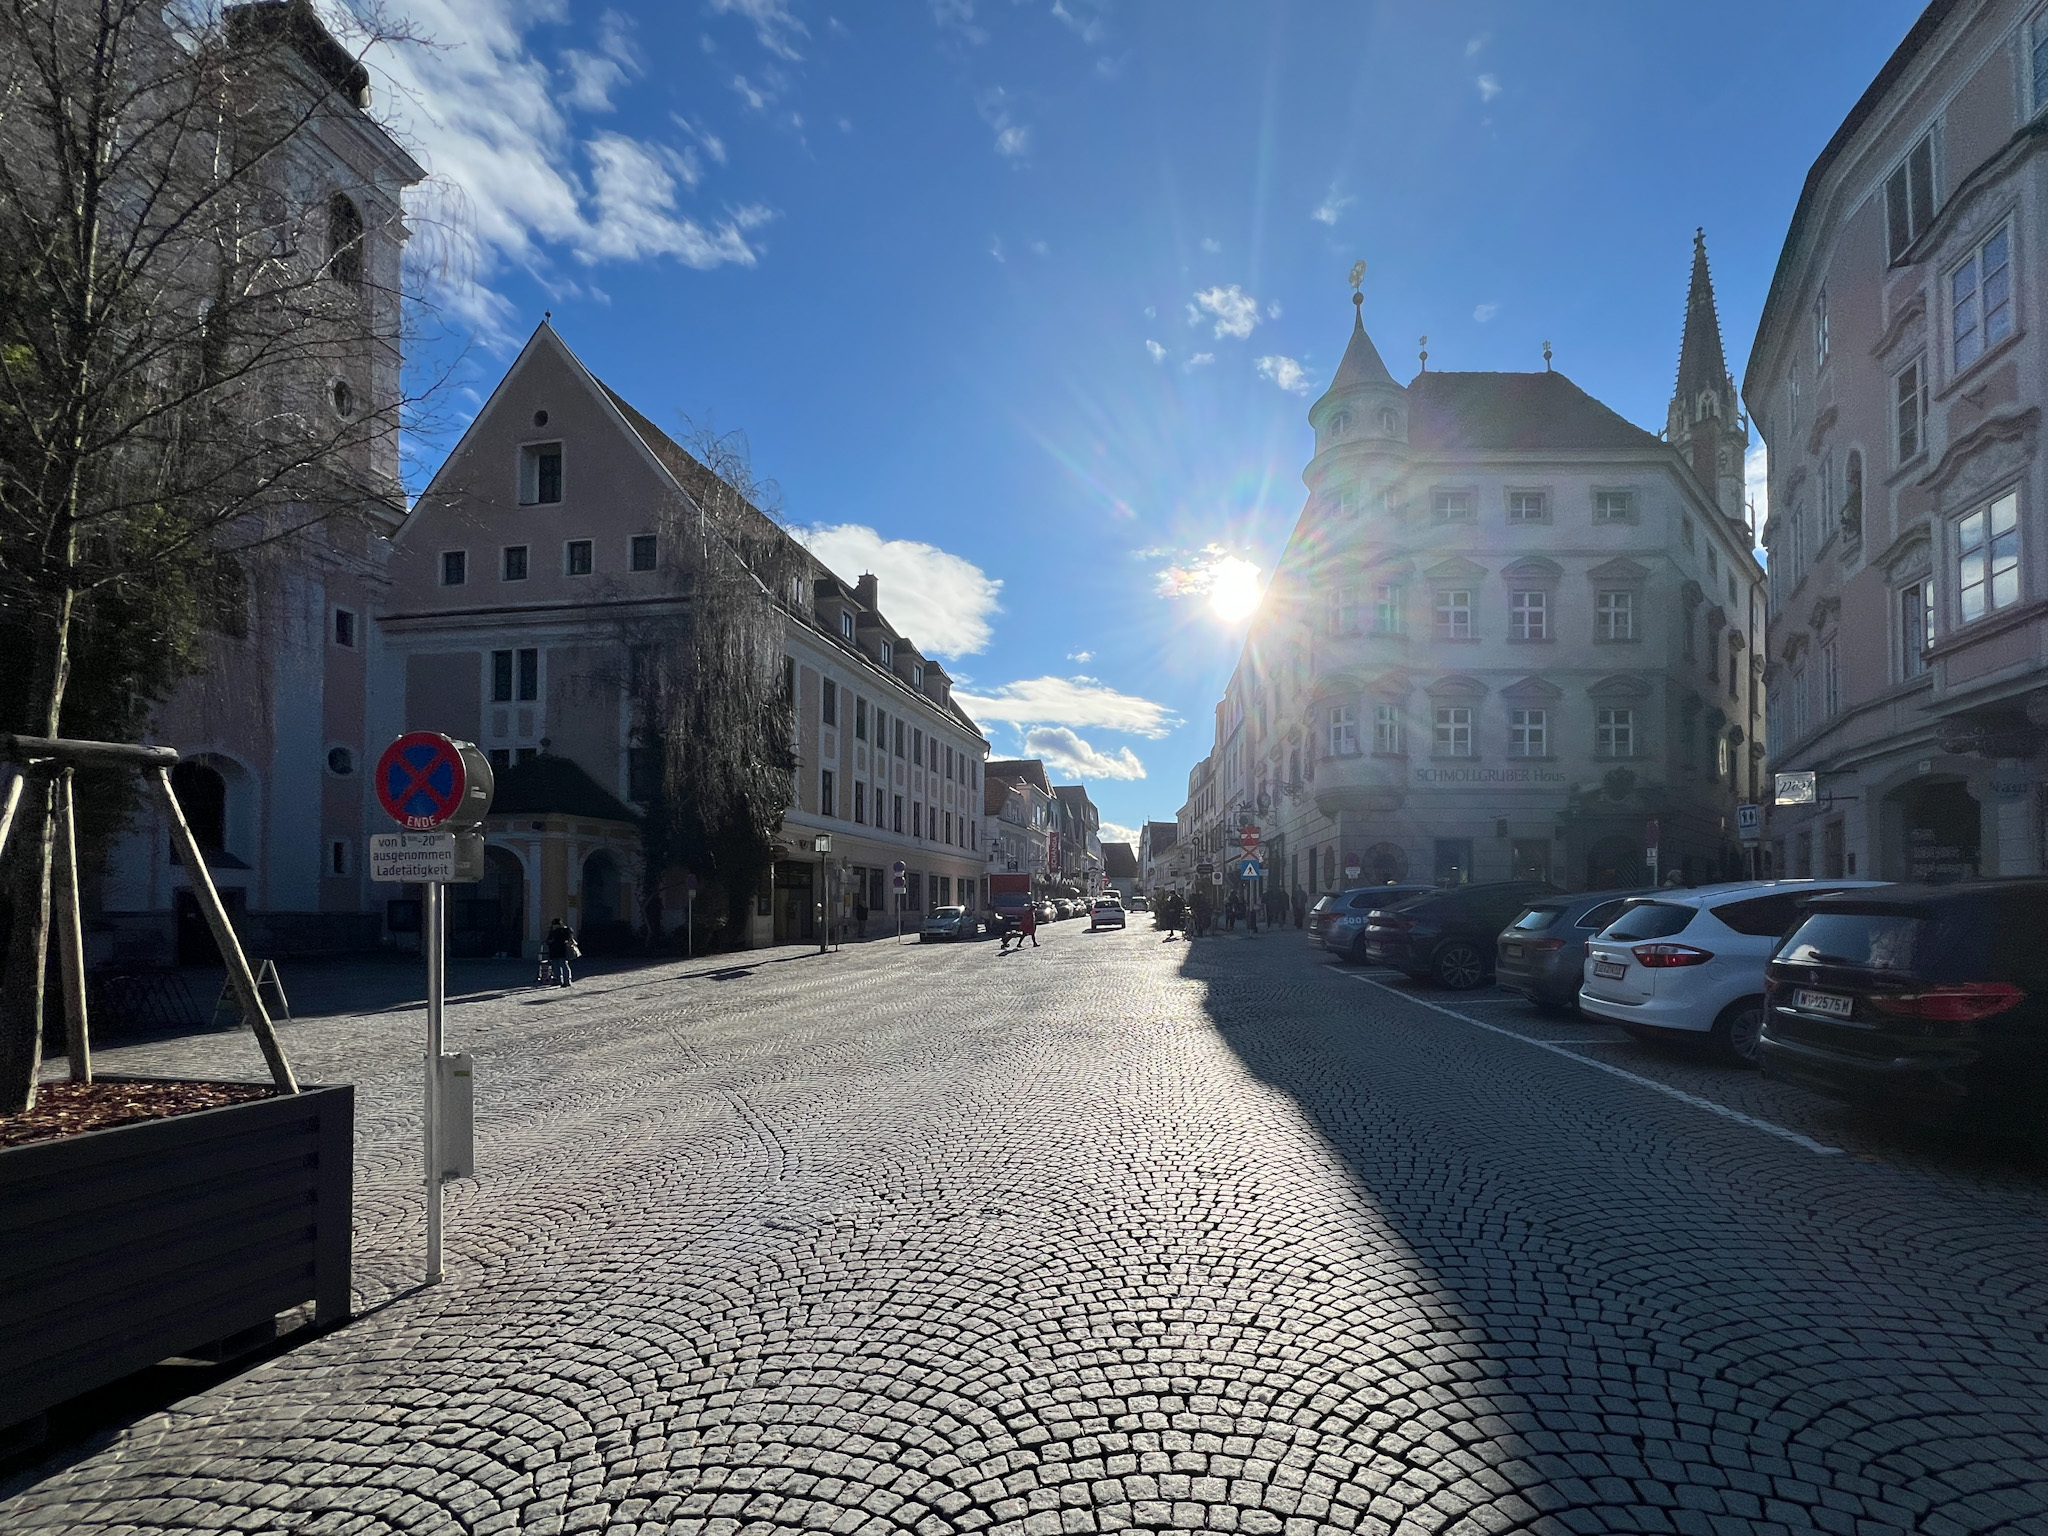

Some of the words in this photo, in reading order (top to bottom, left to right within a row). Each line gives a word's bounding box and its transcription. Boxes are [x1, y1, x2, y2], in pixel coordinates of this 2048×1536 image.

[1416, 768, 1529, 782] SCHMOLLGRUBER
[1534, 767, 1566, 782] Haus
[407, 815, 436, 828] ENDE
[378, 838, 397, 847] von
[373, 850, 451, 863] ausgenommen
[377, 863, 448, 878] Ladetätigkeit
